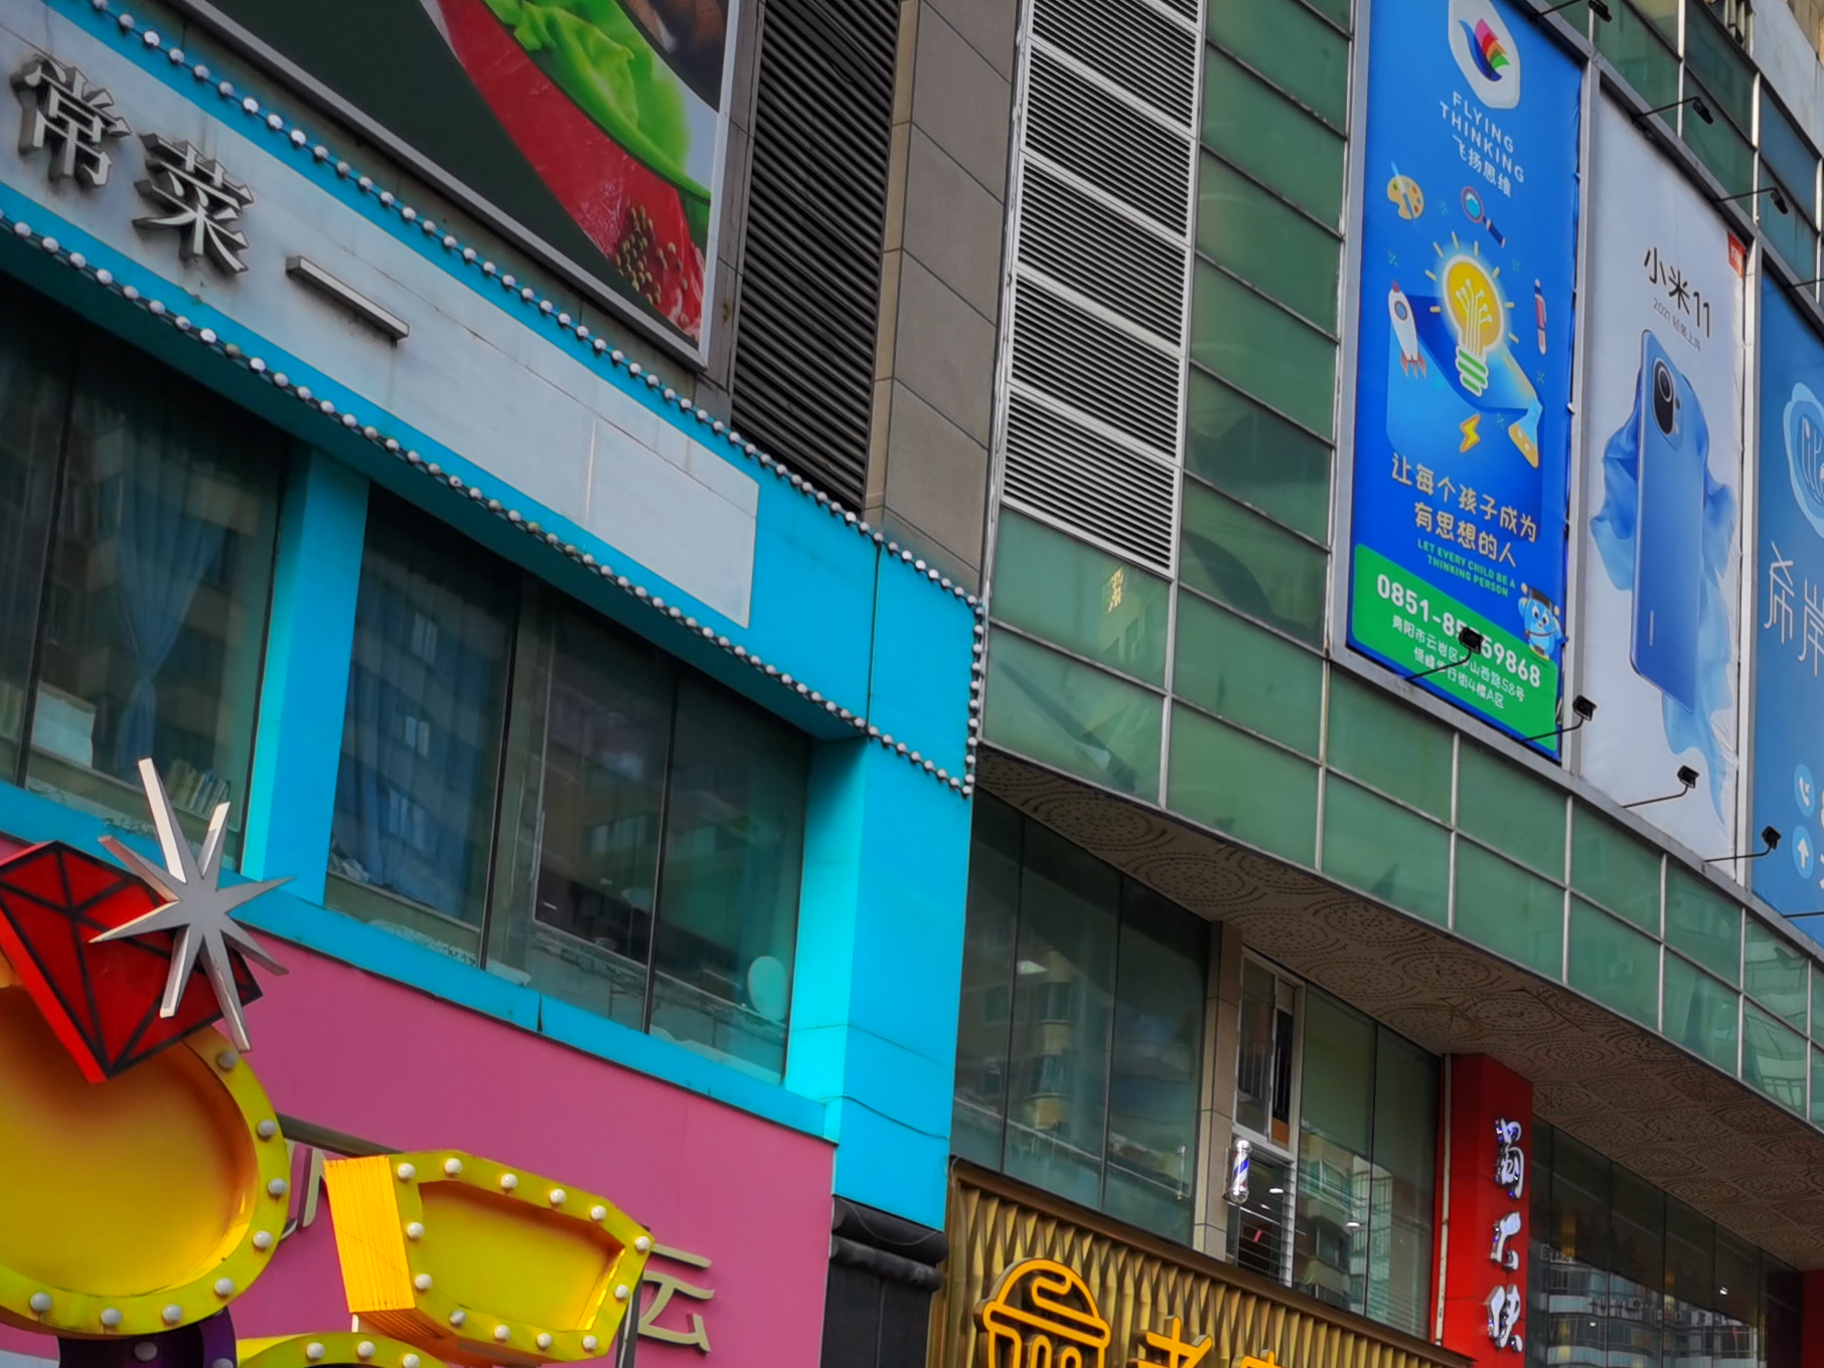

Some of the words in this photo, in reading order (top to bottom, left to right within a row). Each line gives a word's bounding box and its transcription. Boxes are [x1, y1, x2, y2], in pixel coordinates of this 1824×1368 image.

[1439, 101, 1525, 184] THINKING
[1452, 90, 1514, 154] FLYING
[1452, 134, 1512, 198] 飞扬思维
[1644, 247, 1710, 338] 小米11
[1391, 452, 1537, 543] 让每个孩子成为
[1414, 502, 1516, 568] 有思想的人
[1417, 539, 1435, 555] LET
[1437, 546, 1466, 569] EVERY
[1467, 558, 1495, 581] CHILD
[1496, 572, 1508, 586] BE
[1509, 579, 1516, 589] A
[1427, 554, 1471, 582] THINKING
[1473, 573, 1509, 598] PERSON
[1377, 573, 1540, 688] 0851-8559868
